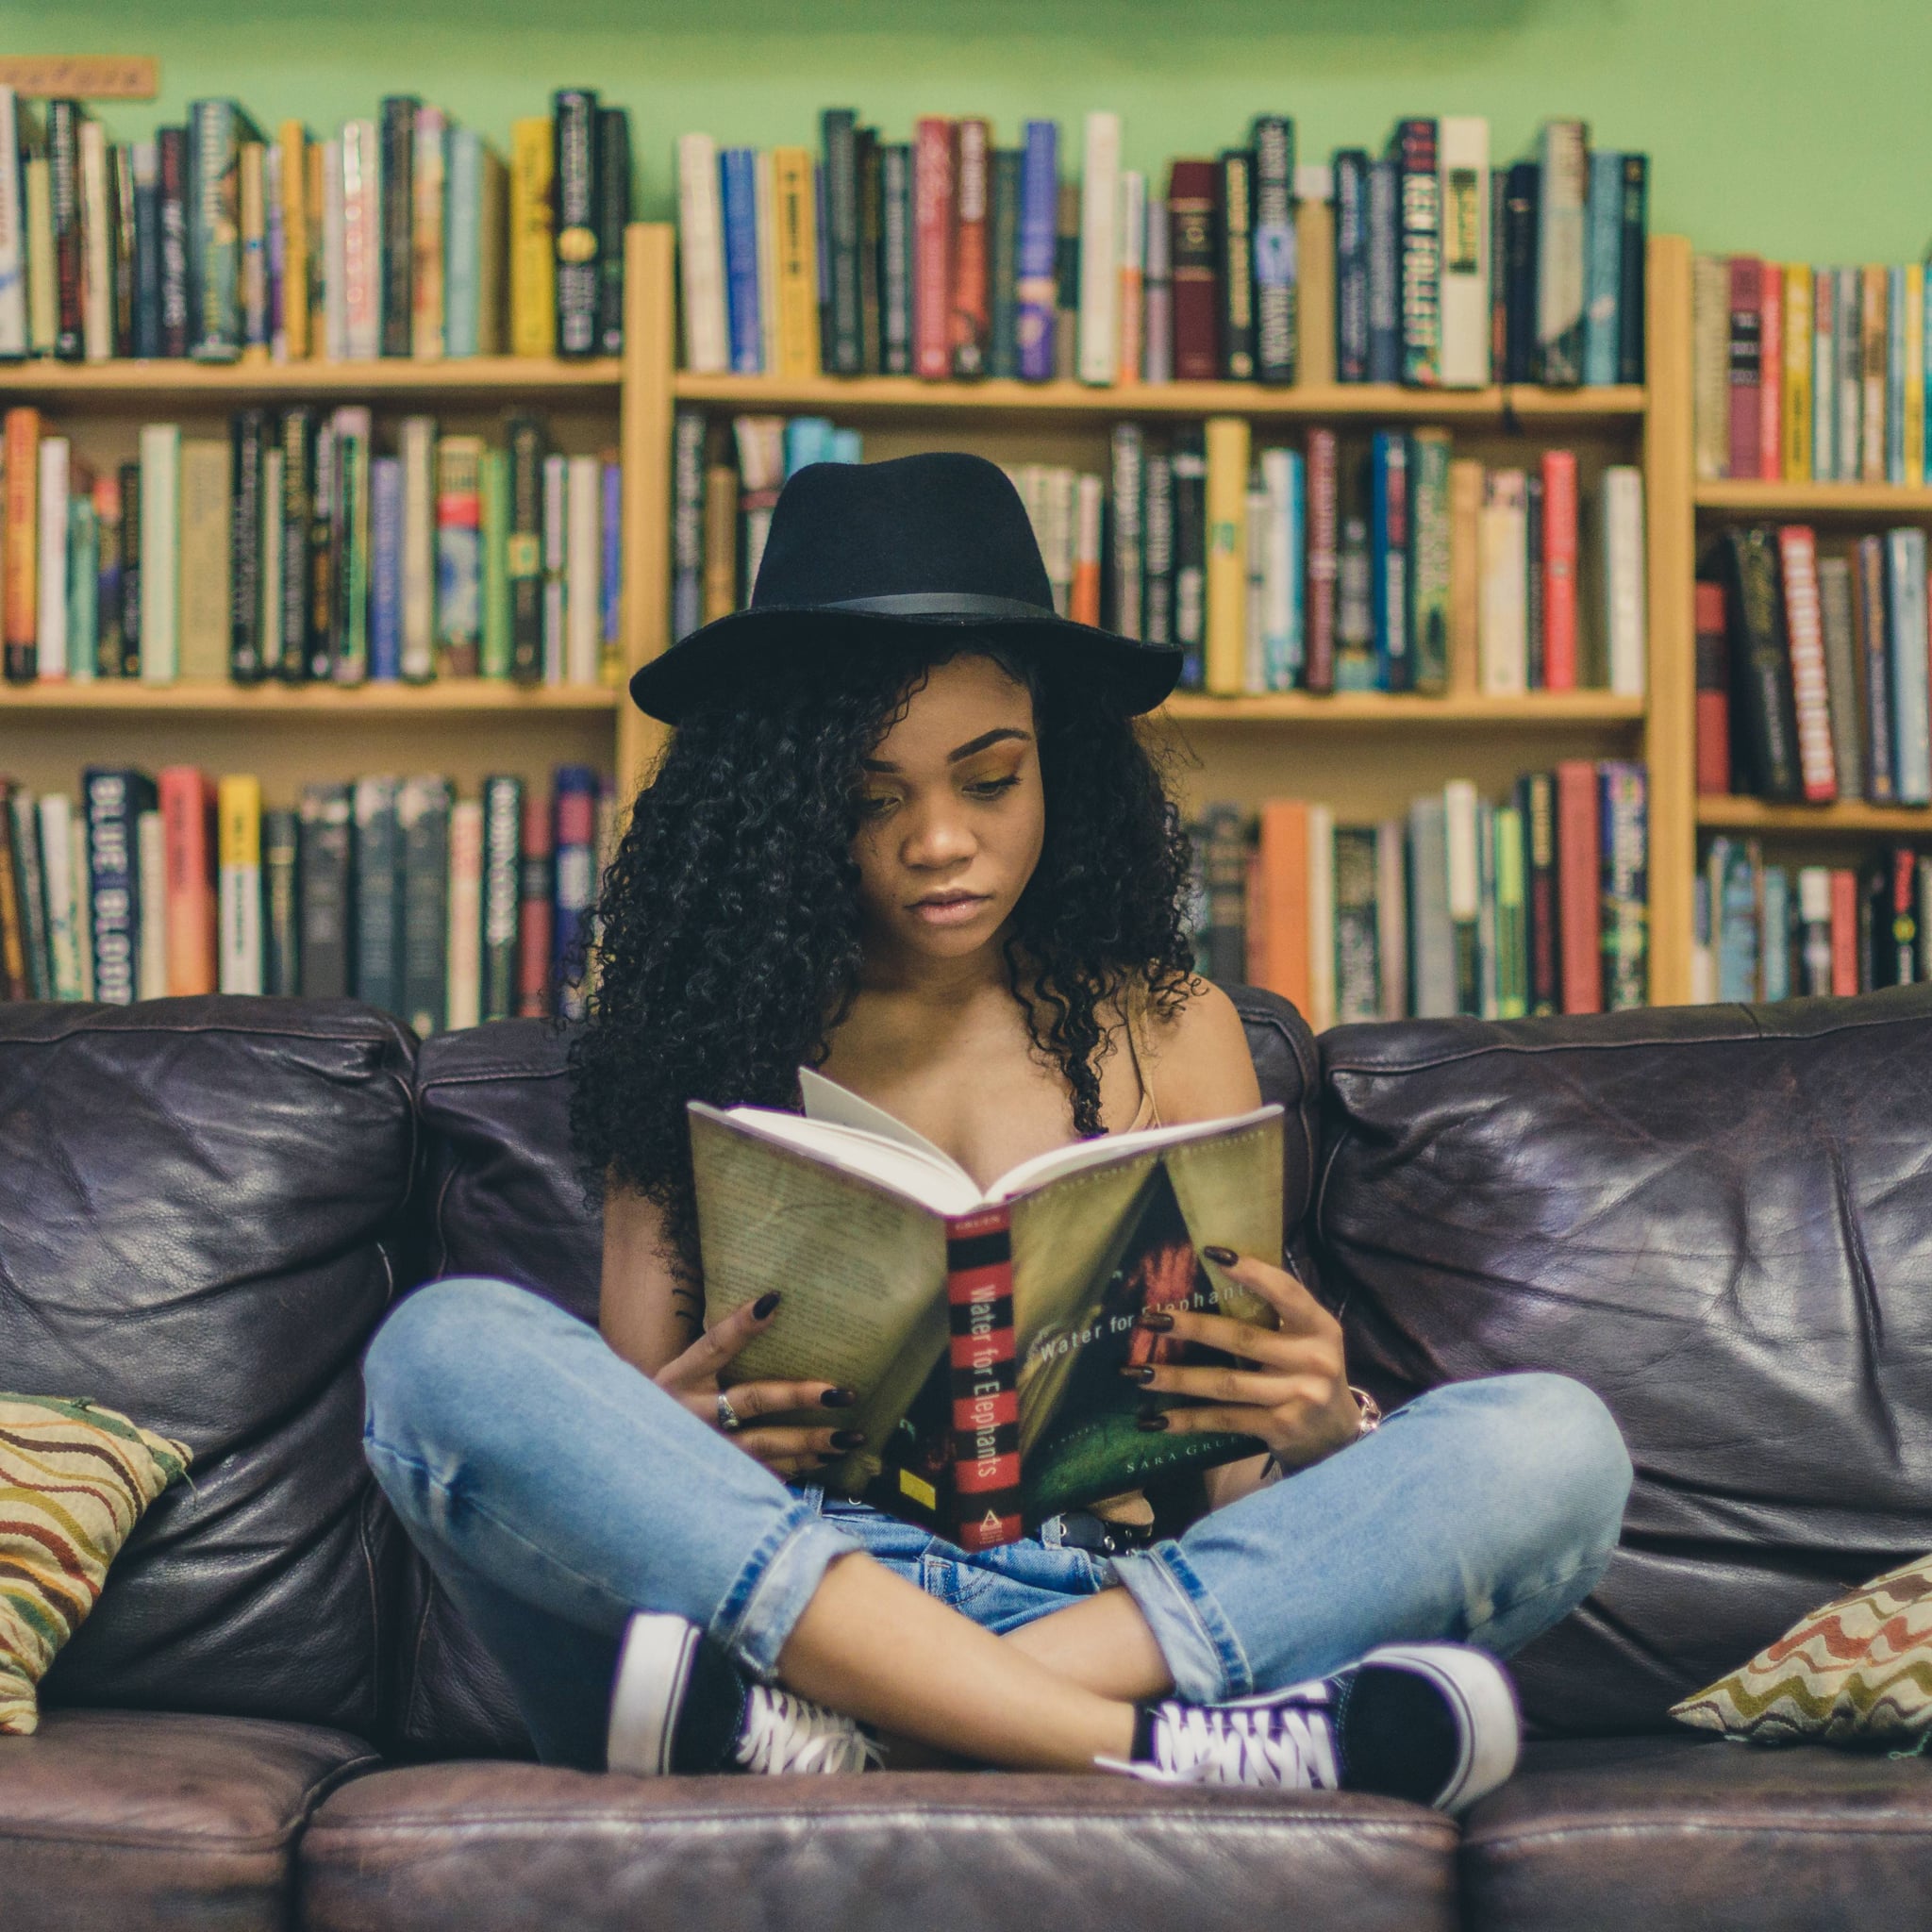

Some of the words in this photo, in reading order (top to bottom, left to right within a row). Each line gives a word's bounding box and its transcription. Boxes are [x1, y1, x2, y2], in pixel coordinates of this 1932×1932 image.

[1405, 176, 1440, 227] KEN
[91, 776, 127, 874] BLUE
[95, 889, 133, 1006] BLOOD
[970, 1284, 997, 1341] Water
[1041, 1325, 1102, 1361] Water
[1110, 1315, 1135, 1333] for
[973, 1349, 999, 1375] for
[970, 1380, 1002, 1478] Elephants
[1126, 1453, 1177, 1474] SARA
